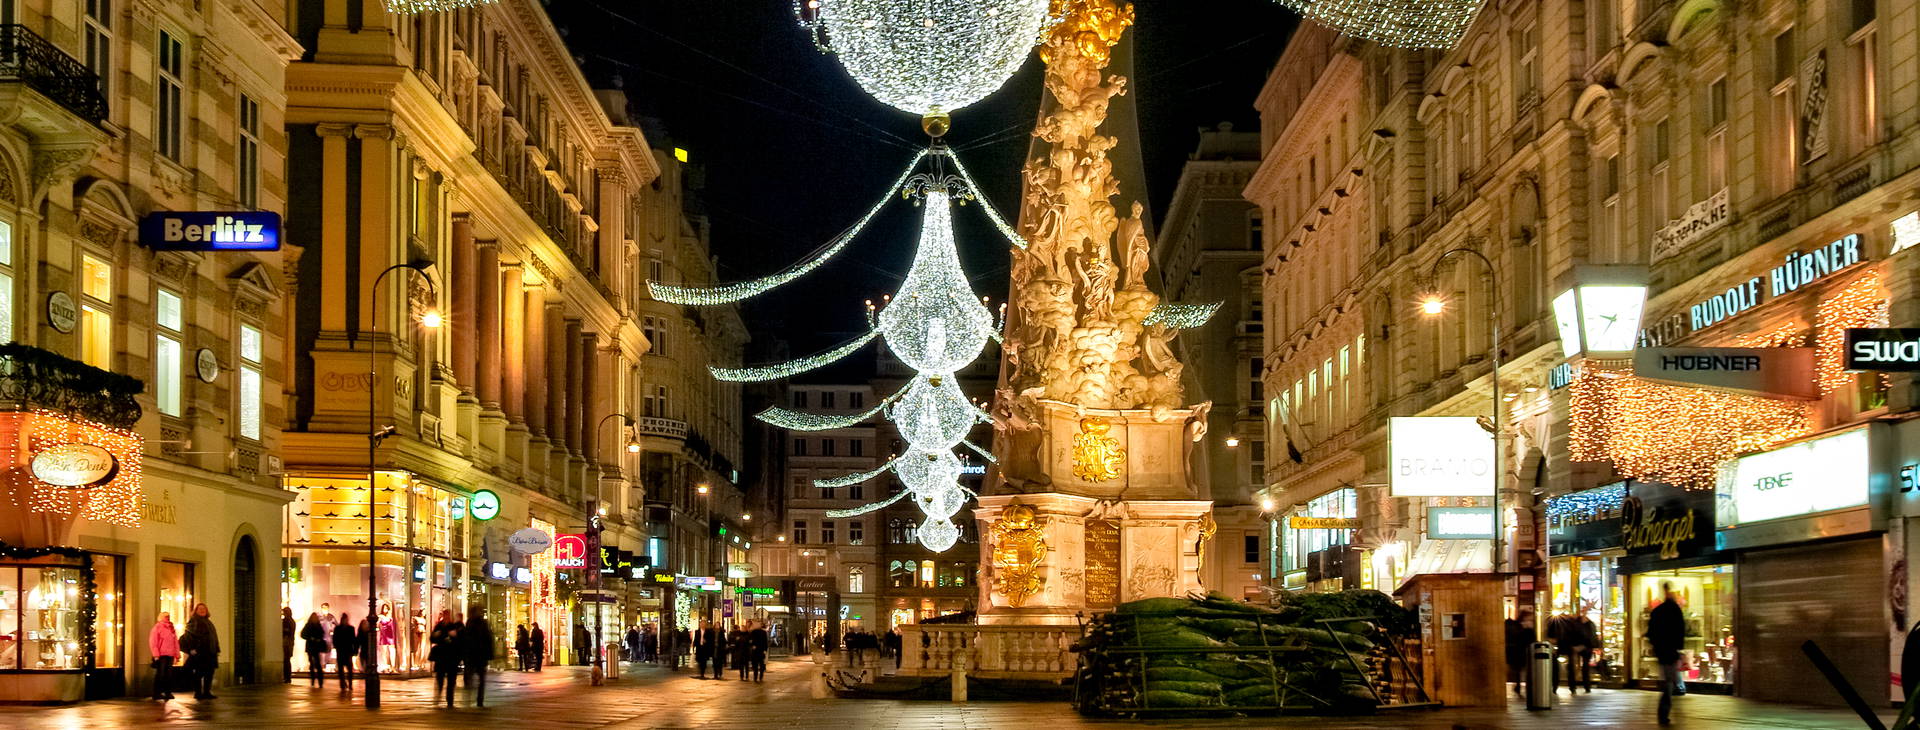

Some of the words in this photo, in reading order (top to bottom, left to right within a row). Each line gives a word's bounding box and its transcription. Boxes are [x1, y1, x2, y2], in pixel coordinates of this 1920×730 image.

[164, 216, 264, 243] Berlitz
[1691, 276, 1761, 332] RUDOLF
[1771, 233, 1860, 297] HÜBNER
[1854, 337, 1920, 362] swa
[1662, 355, 1761, 371] HÜBNER
[798, 579, 825, 588] Cartier
